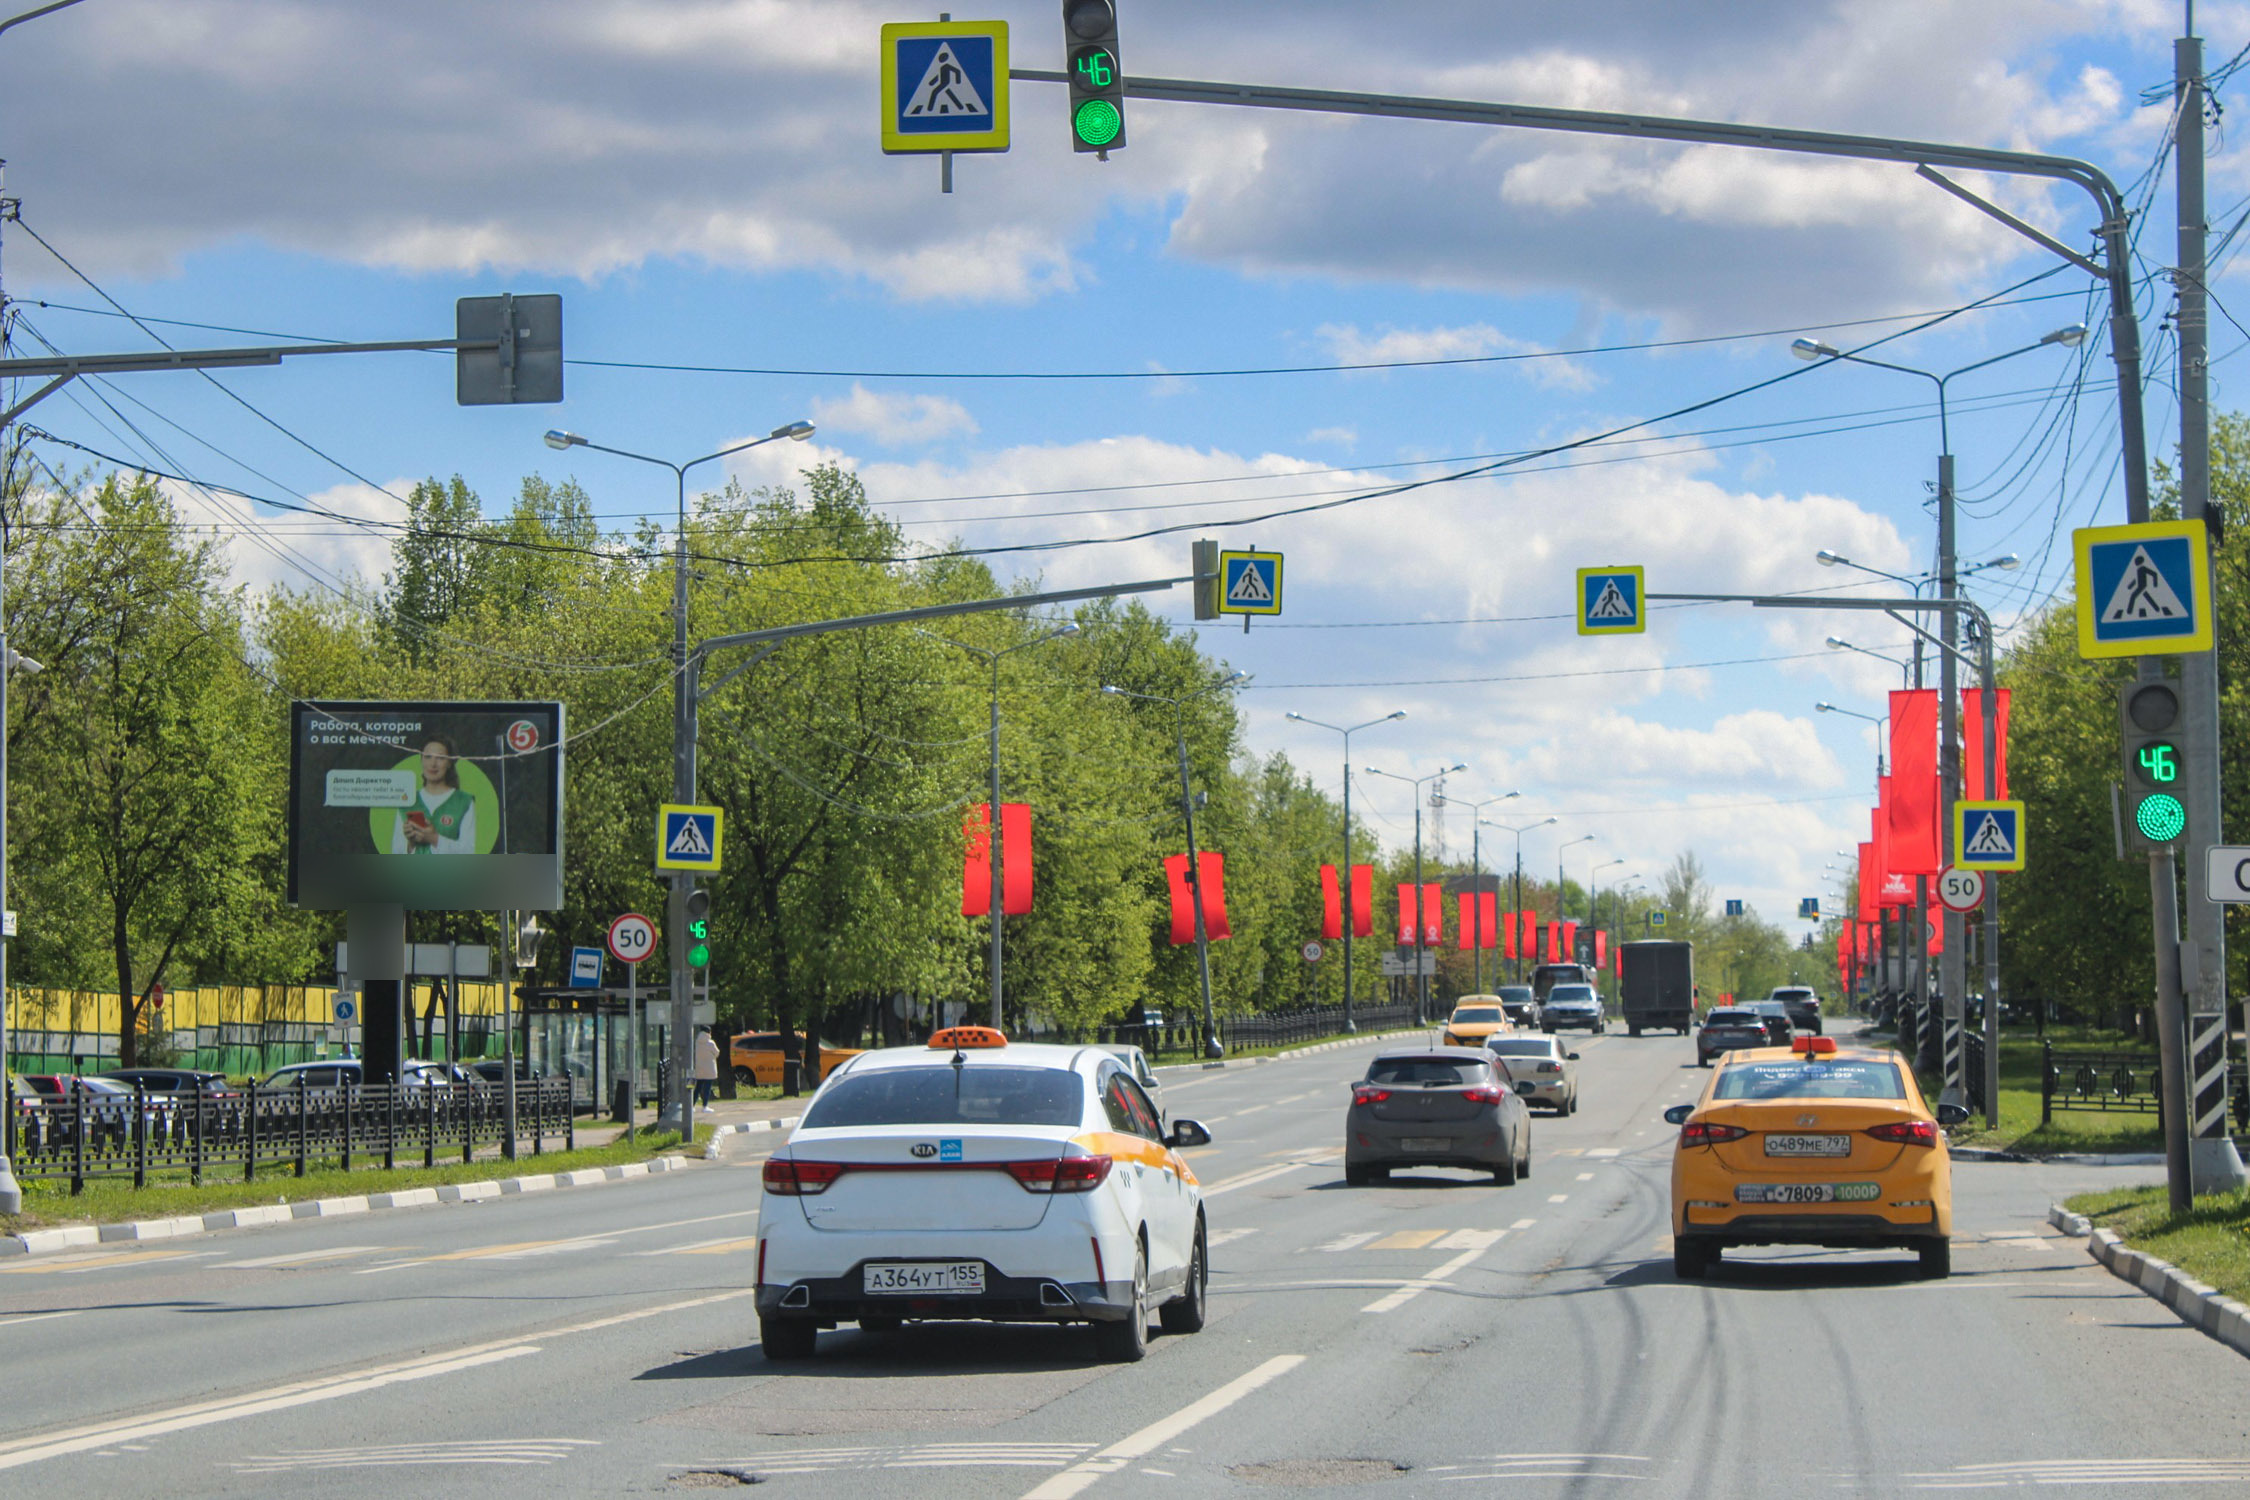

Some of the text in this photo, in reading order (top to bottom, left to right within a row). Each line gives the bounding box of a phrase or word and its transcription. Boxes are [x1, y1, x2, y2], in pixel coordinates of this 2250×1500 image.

[1078, 53, 1111, 86] 46
[366, 722, 422, 734] которая
[310, 735, 407, 745] о вас мечтает
[2140, 745, 2175, 781] 46
[1948, 878, 1974, 896] 50
[689, 921, 706, 939] 46
[620, 929, 646, 948] 50
[1306, 947, 1319, 956] 50
[913, 1145, 934, 1155] KIA
[1769, 1137, 1846, 1151] О489МЕ 797
[1784, 1186, 1823, 1201] 7809
[872, 1265, 977, 1288] А364УТ 155
